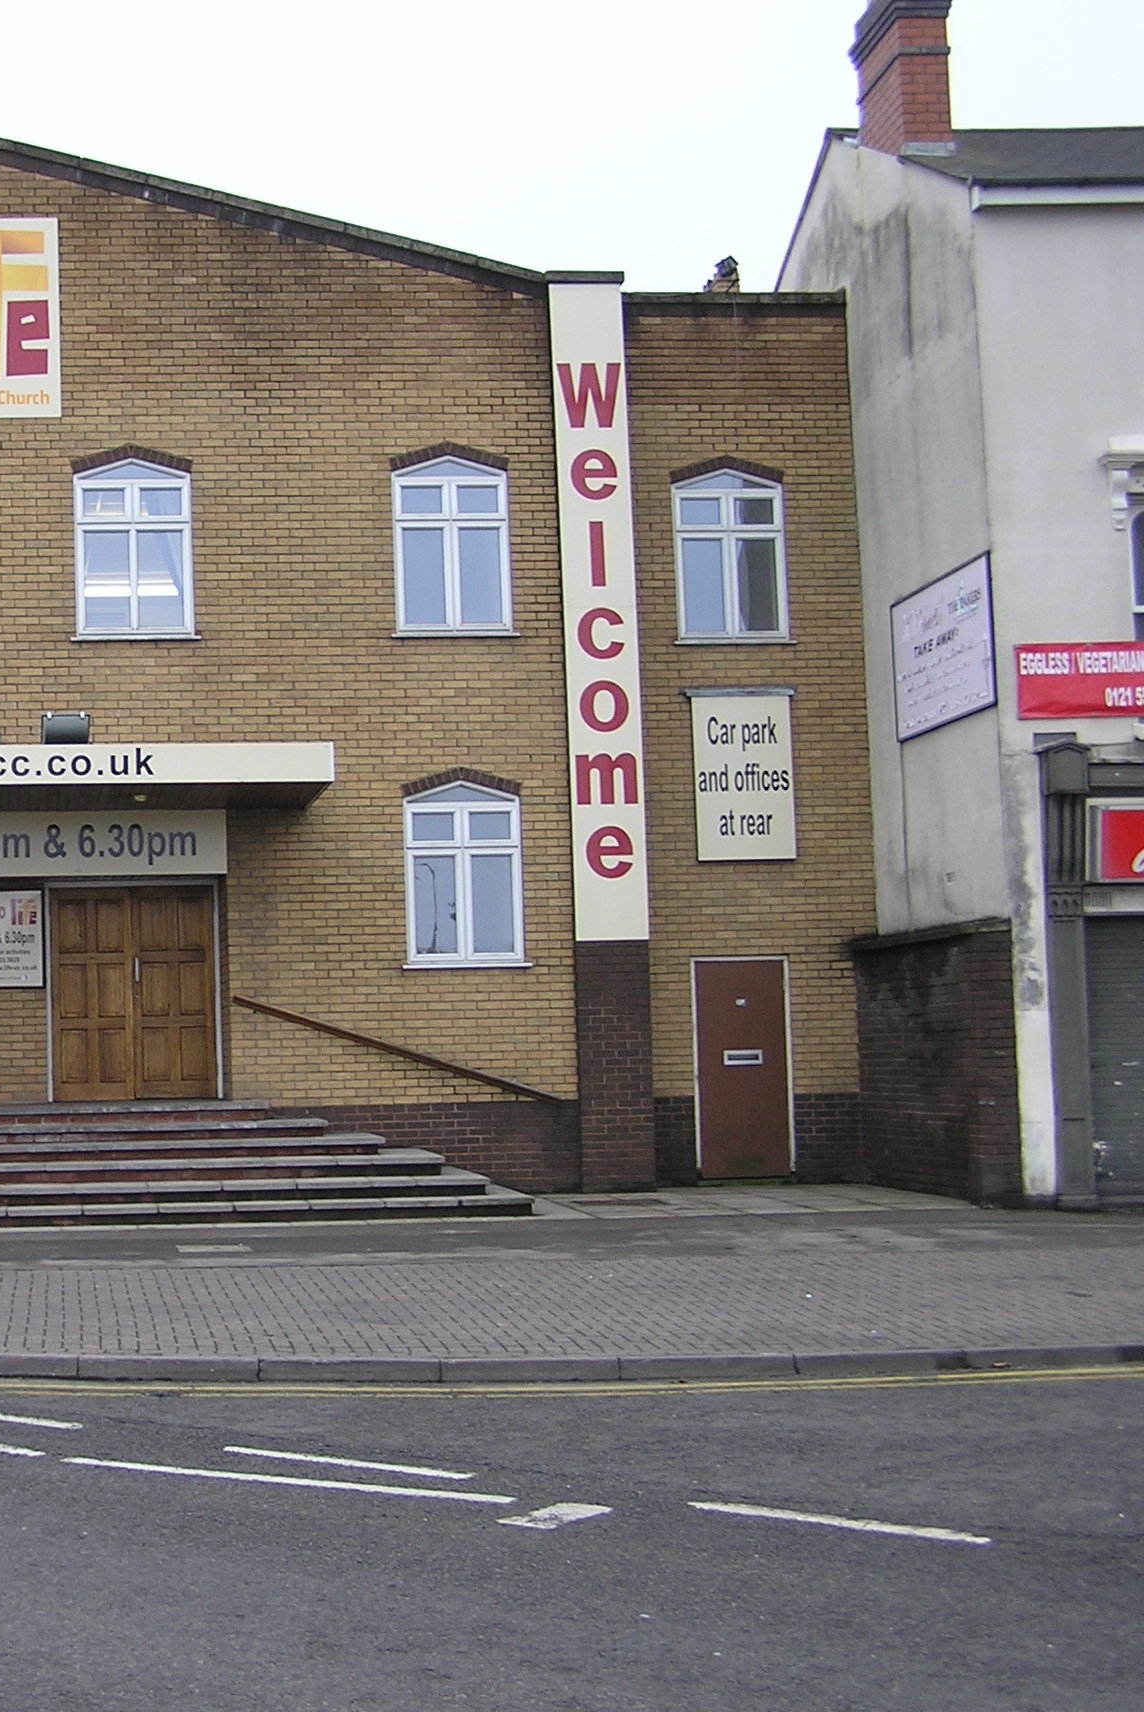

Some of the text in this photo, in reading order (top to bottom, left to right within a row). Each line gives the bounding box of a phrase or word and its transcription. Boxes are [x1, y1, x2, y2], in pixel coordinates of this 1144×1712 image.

[556, 362, 638, 879] Welcome
[1019, 652, 1069, 675] EGGLESS
[1105, 686, 1133, 707] 0121
[707, 716, 778, 751] Car park
[698, 763, 790, 792] and offices
[719, 809, 772, 836] at rear
[44, 823, 66, 859] &
[78, 823, 197, 865] 6.30pm
[11, 898, 37, 925] life
[5, 931, 35, 946] 6.30pm
